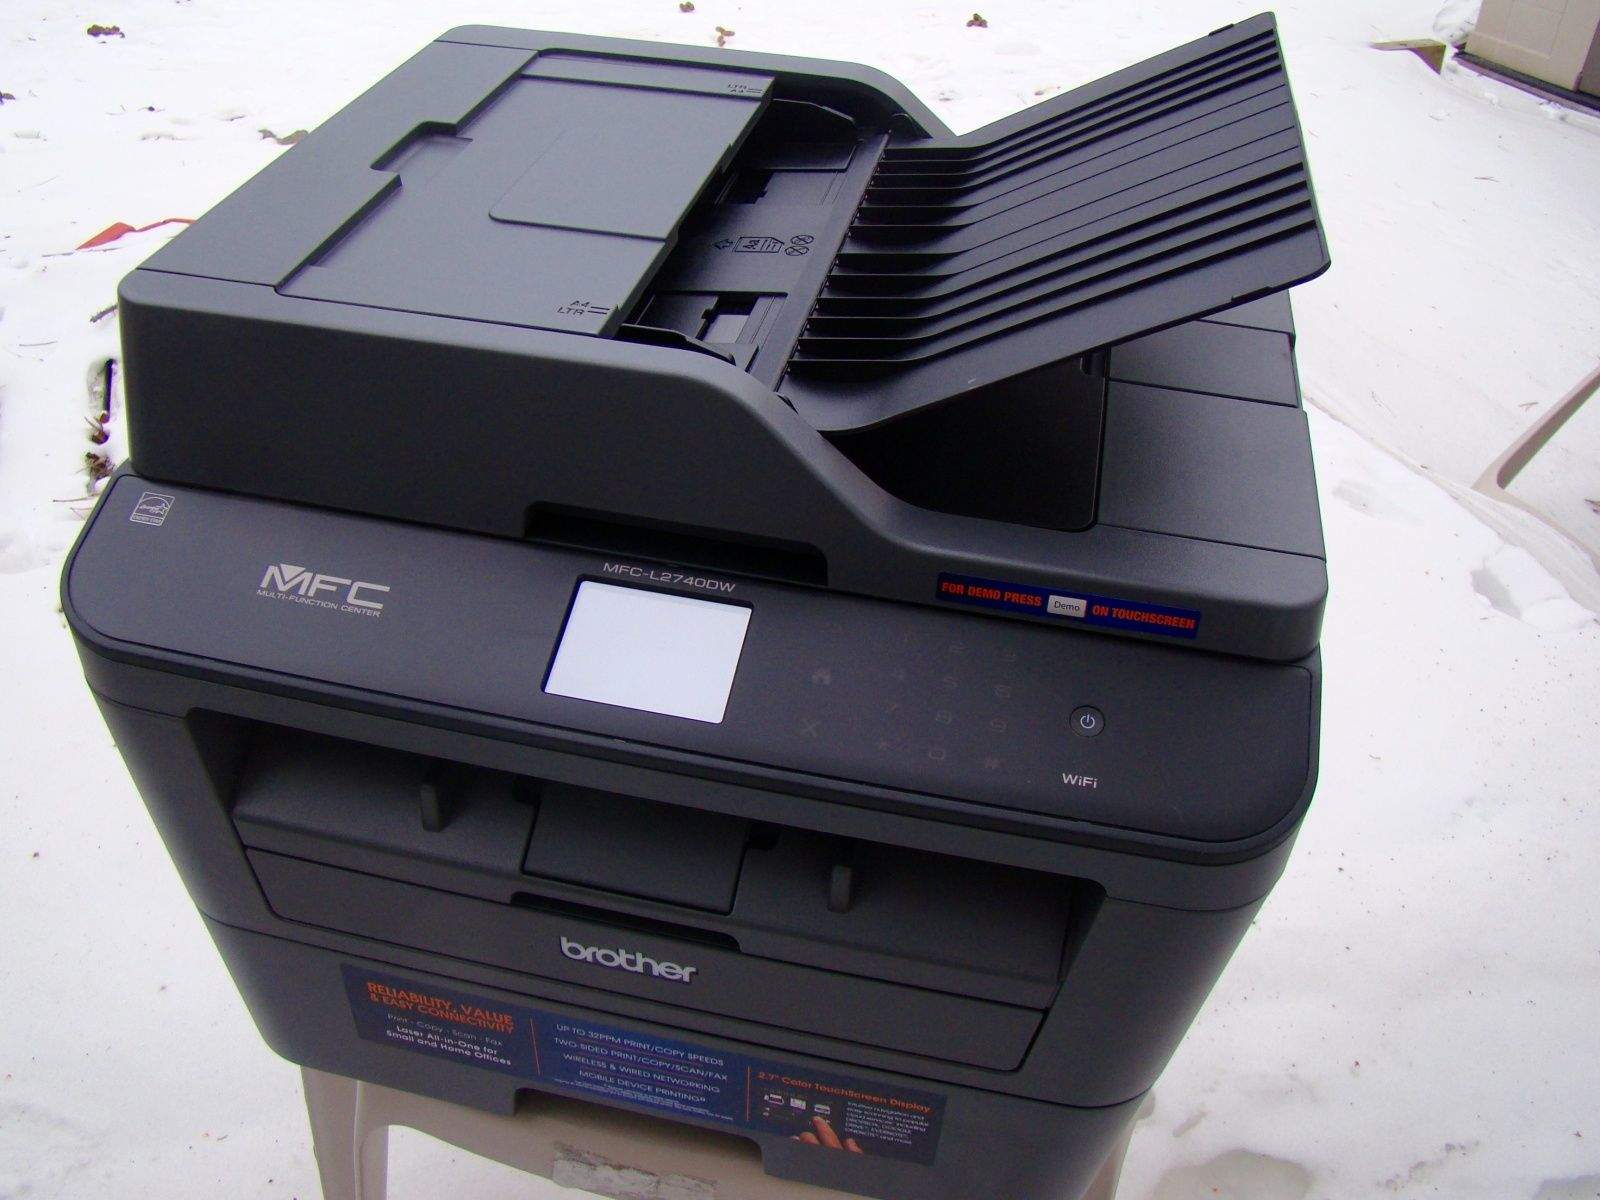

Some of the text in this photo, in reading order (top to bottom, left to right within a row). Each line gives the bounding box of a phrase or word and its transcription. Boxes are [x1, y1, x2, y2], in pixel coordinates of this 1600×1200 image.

[557, 306, 585, 316] LTR
[260, 563, 391, 609] MFC
[602, 562, 736, 593] MFC-L2740DW
[256, 589, 382, 618] MULTI-FUNCTION CENTER
[941, 582, 1197, 629] FOR DEMO PRESS Demo ON TOUCHSCREEN
[1062, 772, 1099, 789] WiFi
[560, 936, 697, 983] brother
[382, 994, 413, 1011] EASY
[416, 1004, 515, 1034] CONNECTIVITY
[460, 1003, 514, 1026] VALUE
[396, 1025, 424, 1037] Laser
[556, 1023, 571, 1032] UP
[571, 1026, 586, 1036] TO
[623, 1038, 685, 1059] PRINT/COPY
[687, 1051, 724, 1067] SPEEDS
[386, 1030, 512, 1066] Small and Home Offices
[563, 1053, 608, 1069] WIRELESS
[619, 1065, 651, 1079] WIRED
[652, 1072, 720, 1093] NETWORKING
[579, 1070, 614, 1084] MOBILE
[616, 1077, 652, 1092] DEVICE
